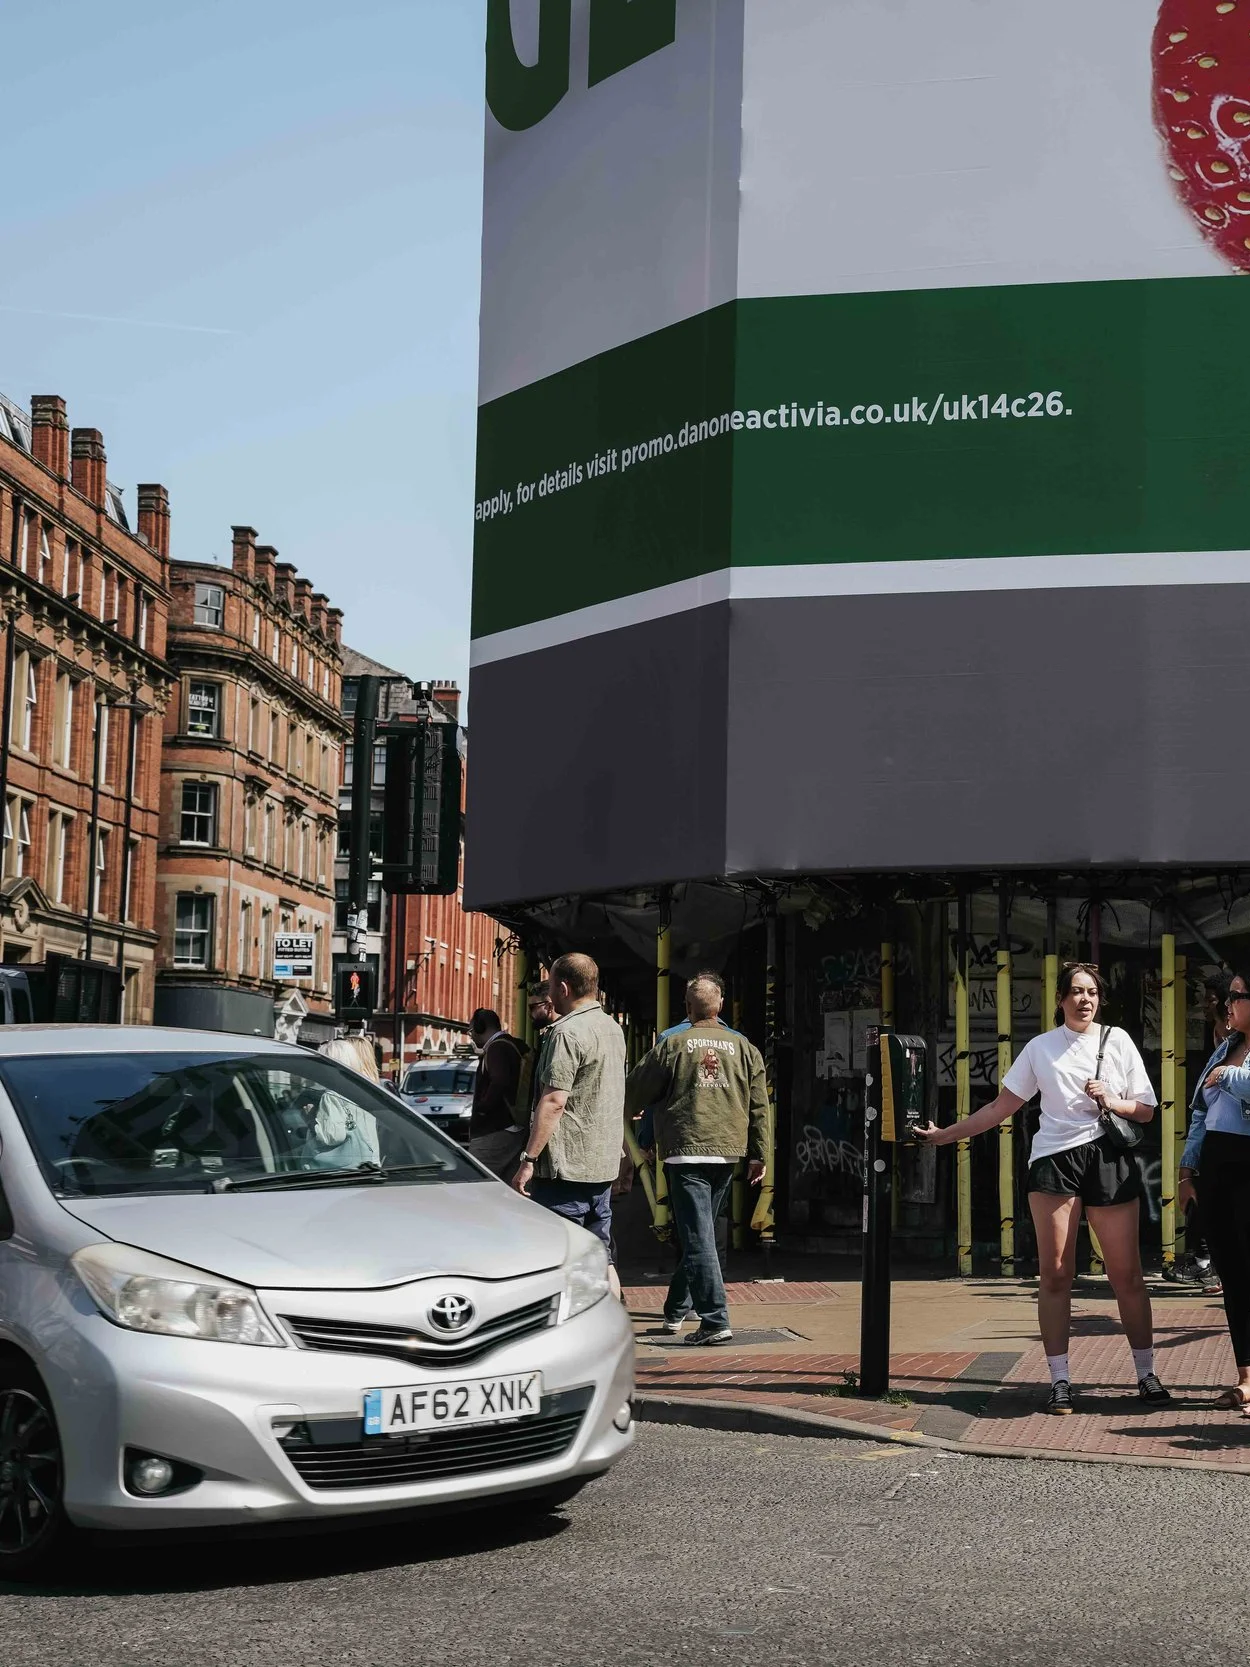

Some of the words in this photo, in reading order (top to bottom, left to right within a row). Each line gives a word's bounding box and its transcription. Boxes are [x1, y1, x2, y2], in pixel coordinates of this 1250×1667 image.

[475, 489, 513, 522] apply,
[517, 482, 536, 505] for
[539, 462, 583, 497] details
[586, 448, 617, 479] visit
[621, 390, 1073, 472] promo.danoneactivia.co.uk/uk14c26.
[276, 938, 291, 947] TO
[293, 938, 313, 948] LET
[686, 1038, 735, 1056] SPORTSMAN'S
[390, 1386, 469, 1426] AF62
[480, 1378, 534, 1415] XNK
